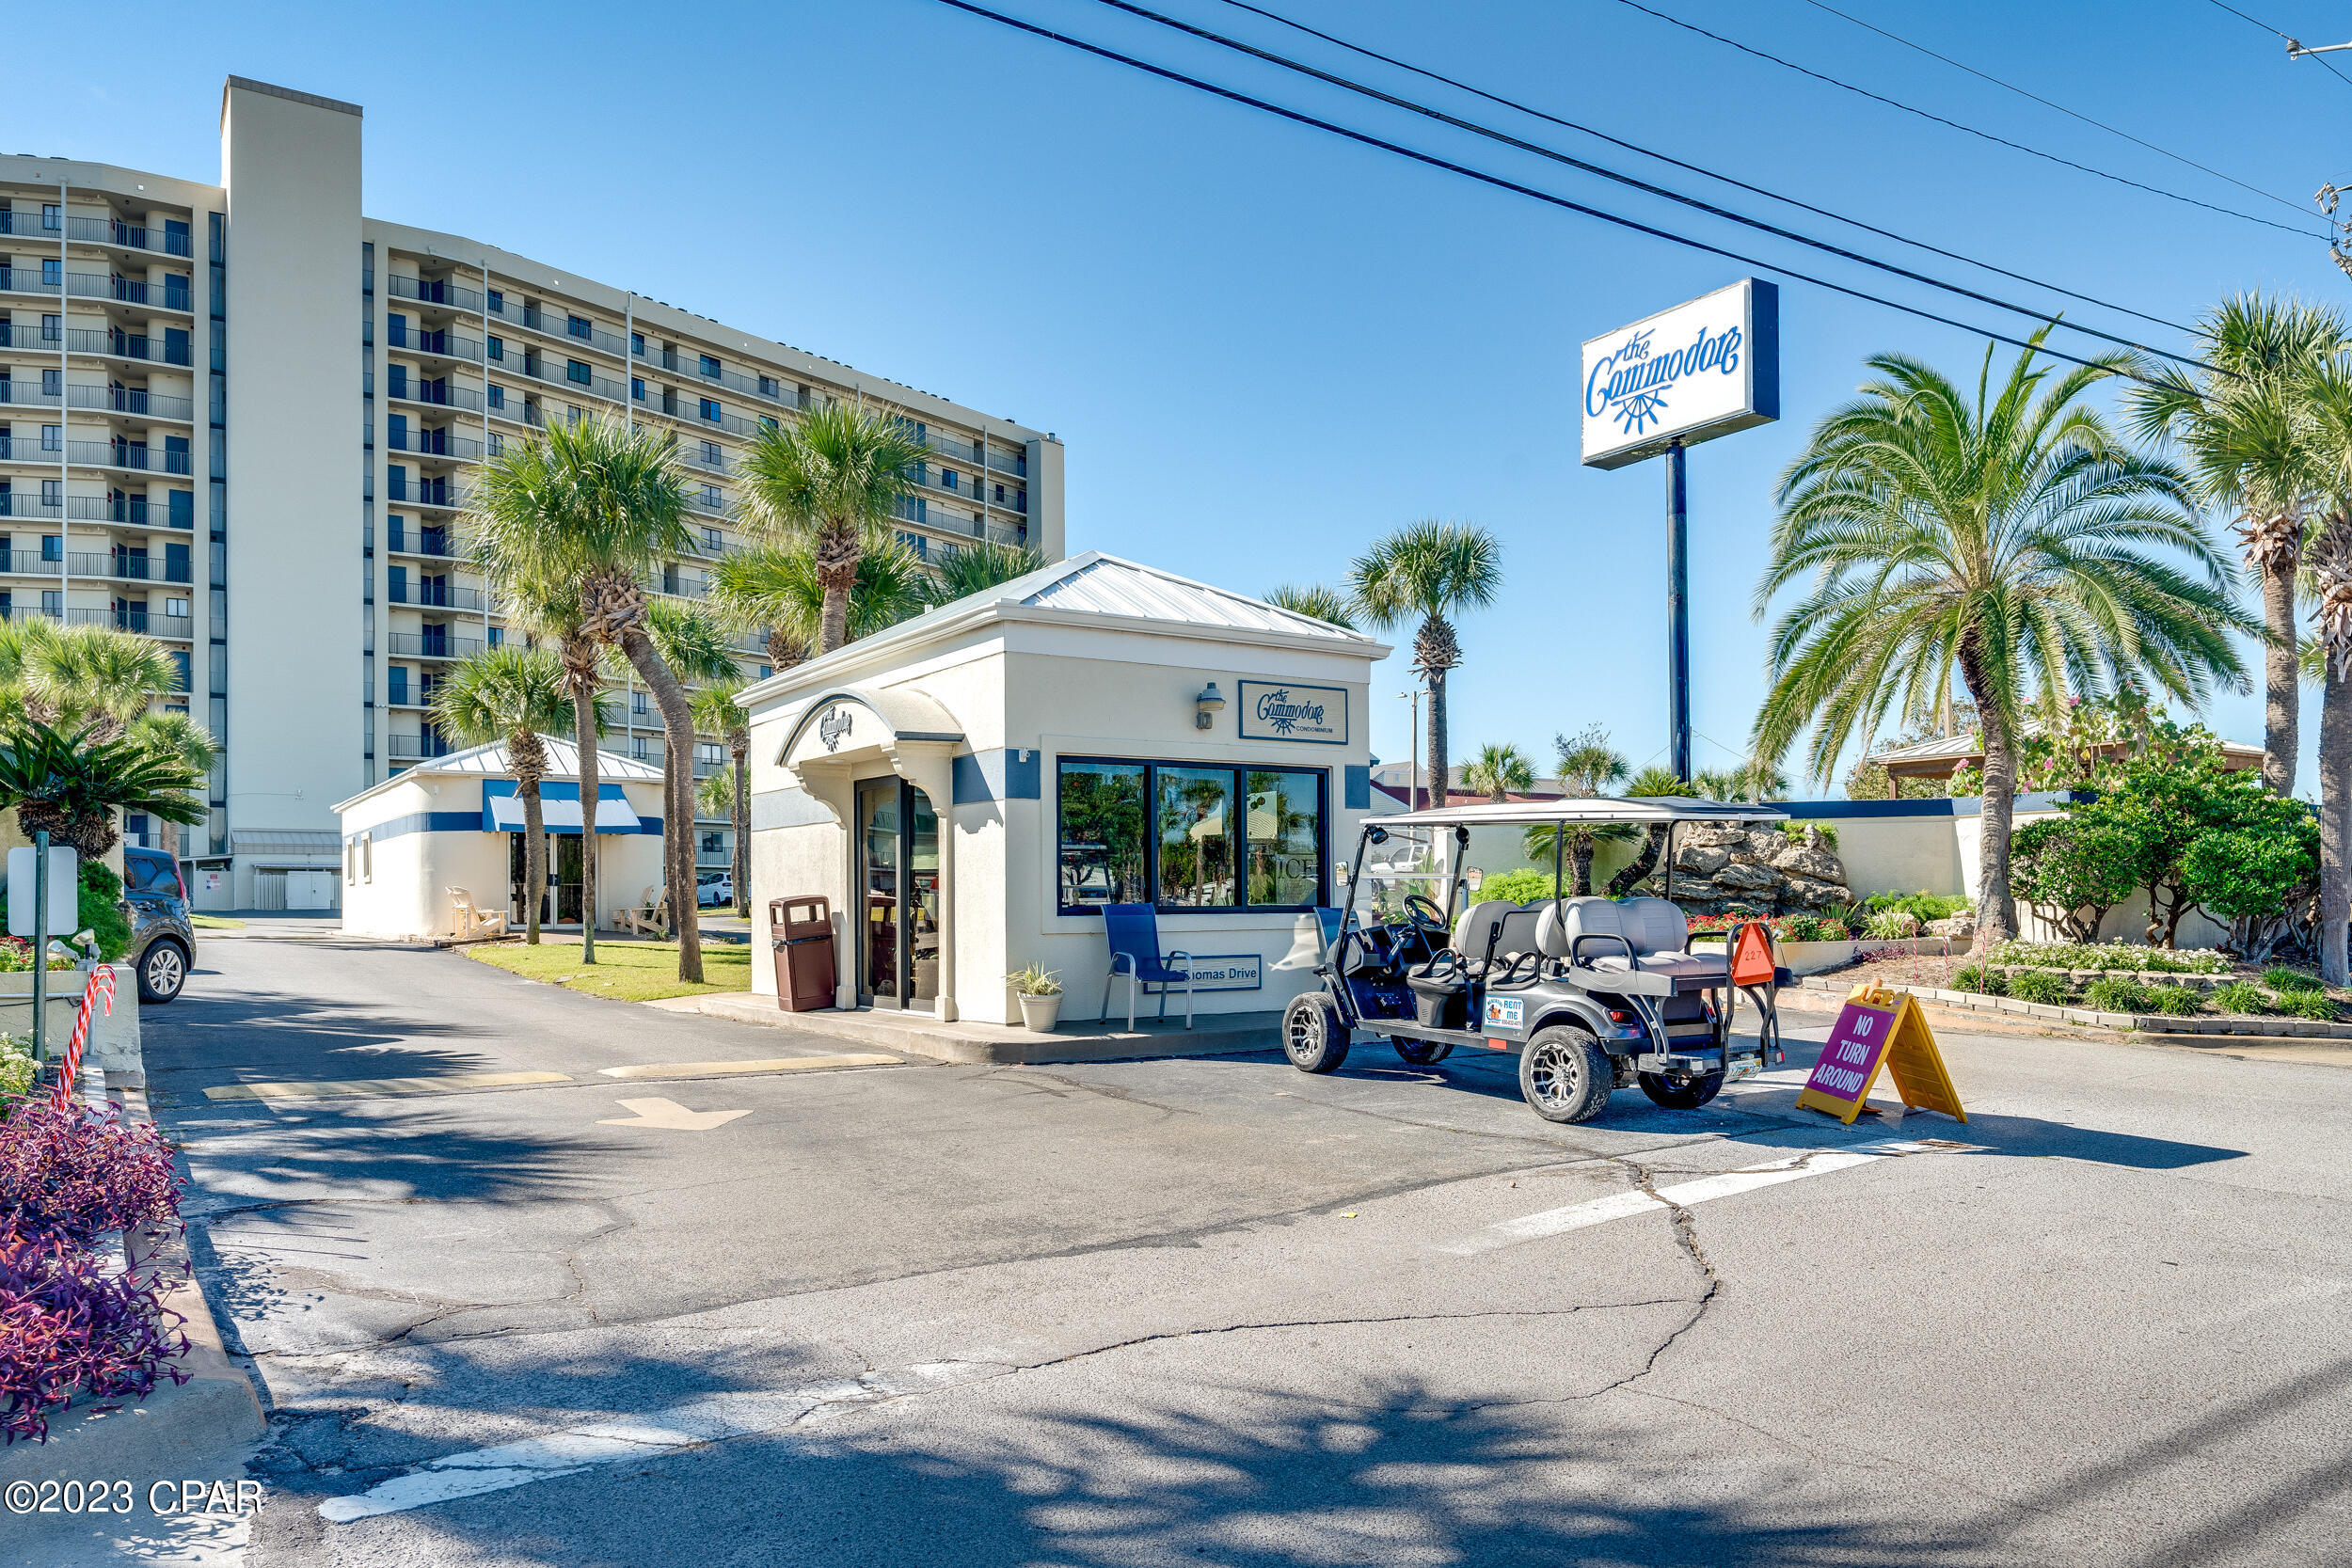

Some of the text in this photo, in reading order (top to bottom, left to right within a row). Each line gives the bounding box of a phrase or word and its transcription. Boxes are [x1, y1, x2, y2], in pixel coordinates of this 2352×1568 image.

[1619, 328, 1656, 361] the
[1586, 325, 1742, 418] Commodore
[1272, 688, 1290, 704] the
[1257, 693, 1325, 725] Commodore
[1295, 725, 1333, 734] CONDOMINIUM
[1744, 950, 1762, 961] 227
[1229, 967, 1257, 979] Drive
[1503, 1000, 1522, 1010] RENT
[1506, 1010, 1518, 1021] ME
[1852, 1014, 1874, 1037] NO
[1836, 1039, 1870, 1066] TURN
[1813, 1063, 1864, 1093] AROUND
